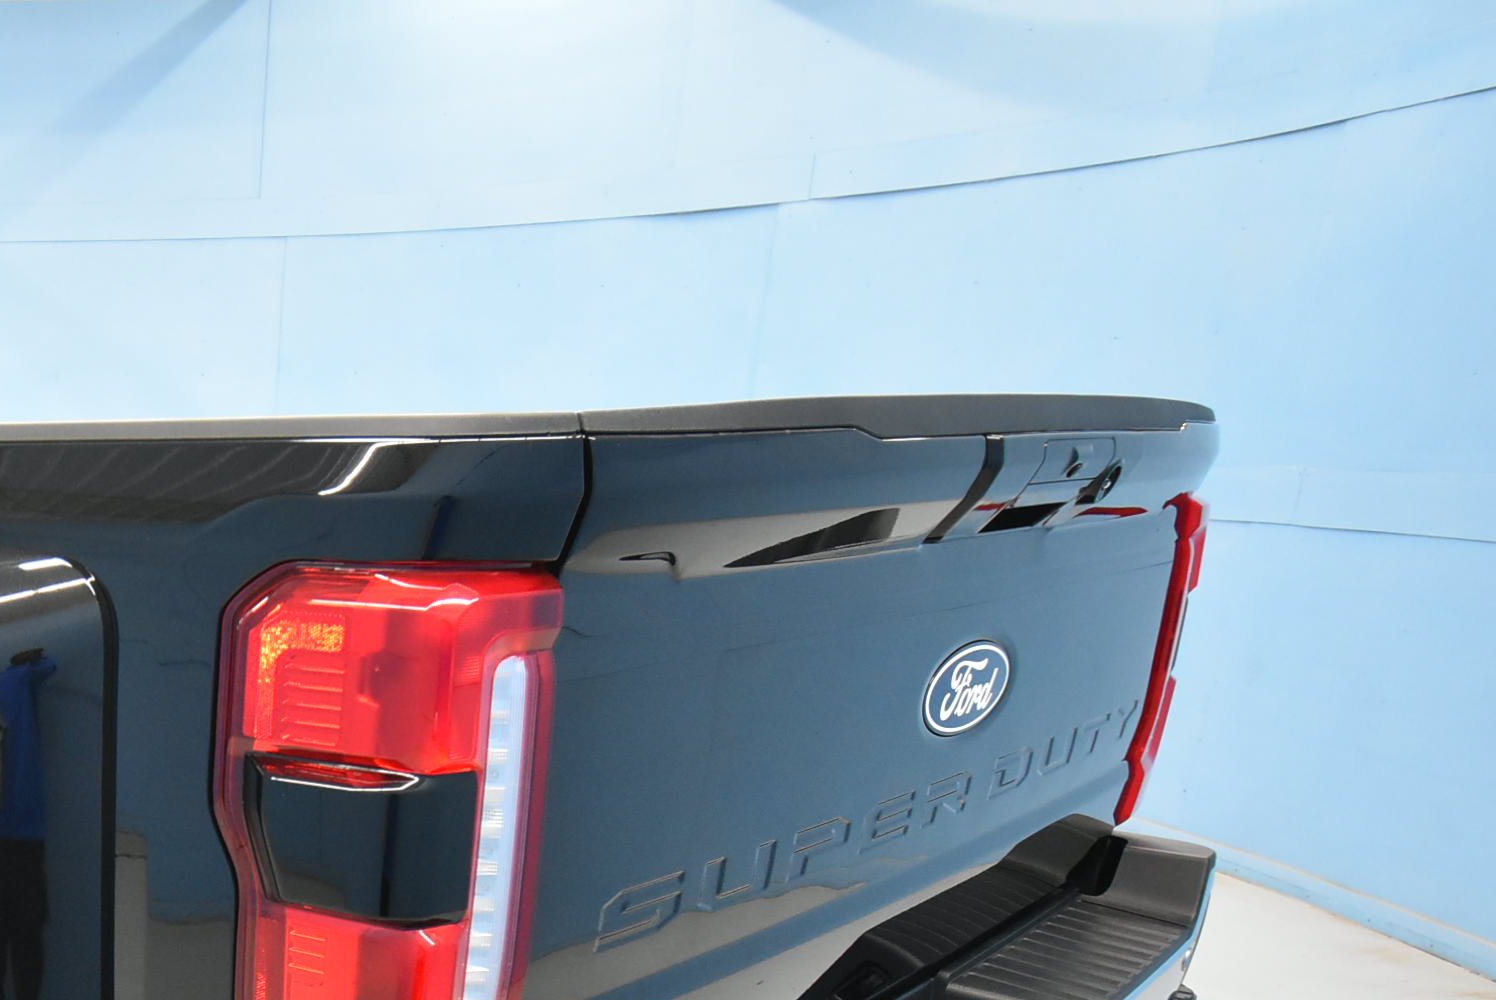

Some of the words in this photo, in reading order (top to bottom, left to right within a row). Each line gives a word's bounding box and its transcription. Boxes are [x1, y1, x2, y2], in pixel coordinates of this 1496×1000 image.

[939, 658, 999, 722] Ford
[592, 770, 972, 953] SUPER
[986, 699, 1139, 801] DUTY
